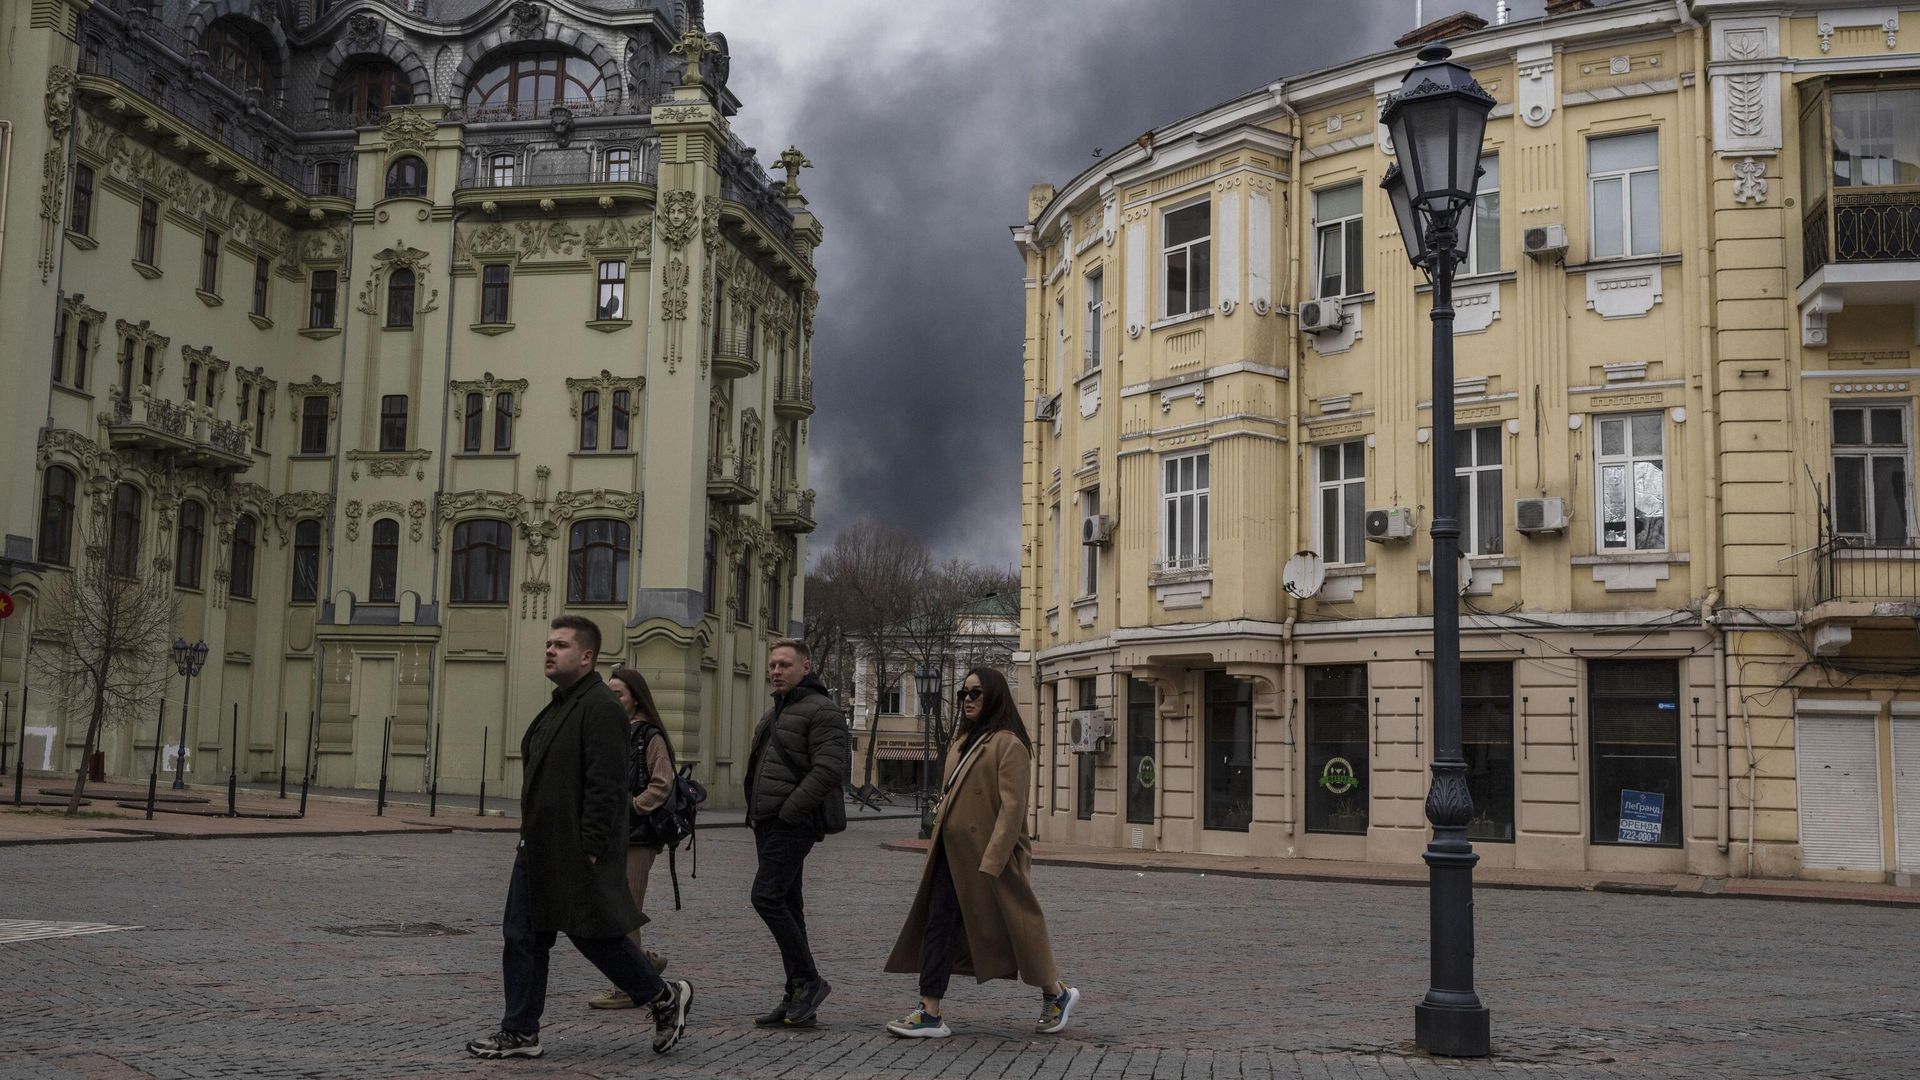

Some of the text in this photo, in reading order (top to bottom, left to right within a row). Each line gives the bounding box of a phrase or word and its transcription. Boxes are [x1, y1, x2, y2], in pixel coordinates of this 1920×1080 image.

[1624, 801, 1660, 814] ЛеГранд
[1621, 820, 1659, 832] ОРЕНДА
[1622, 830, 1658, 842] 722-000-1
